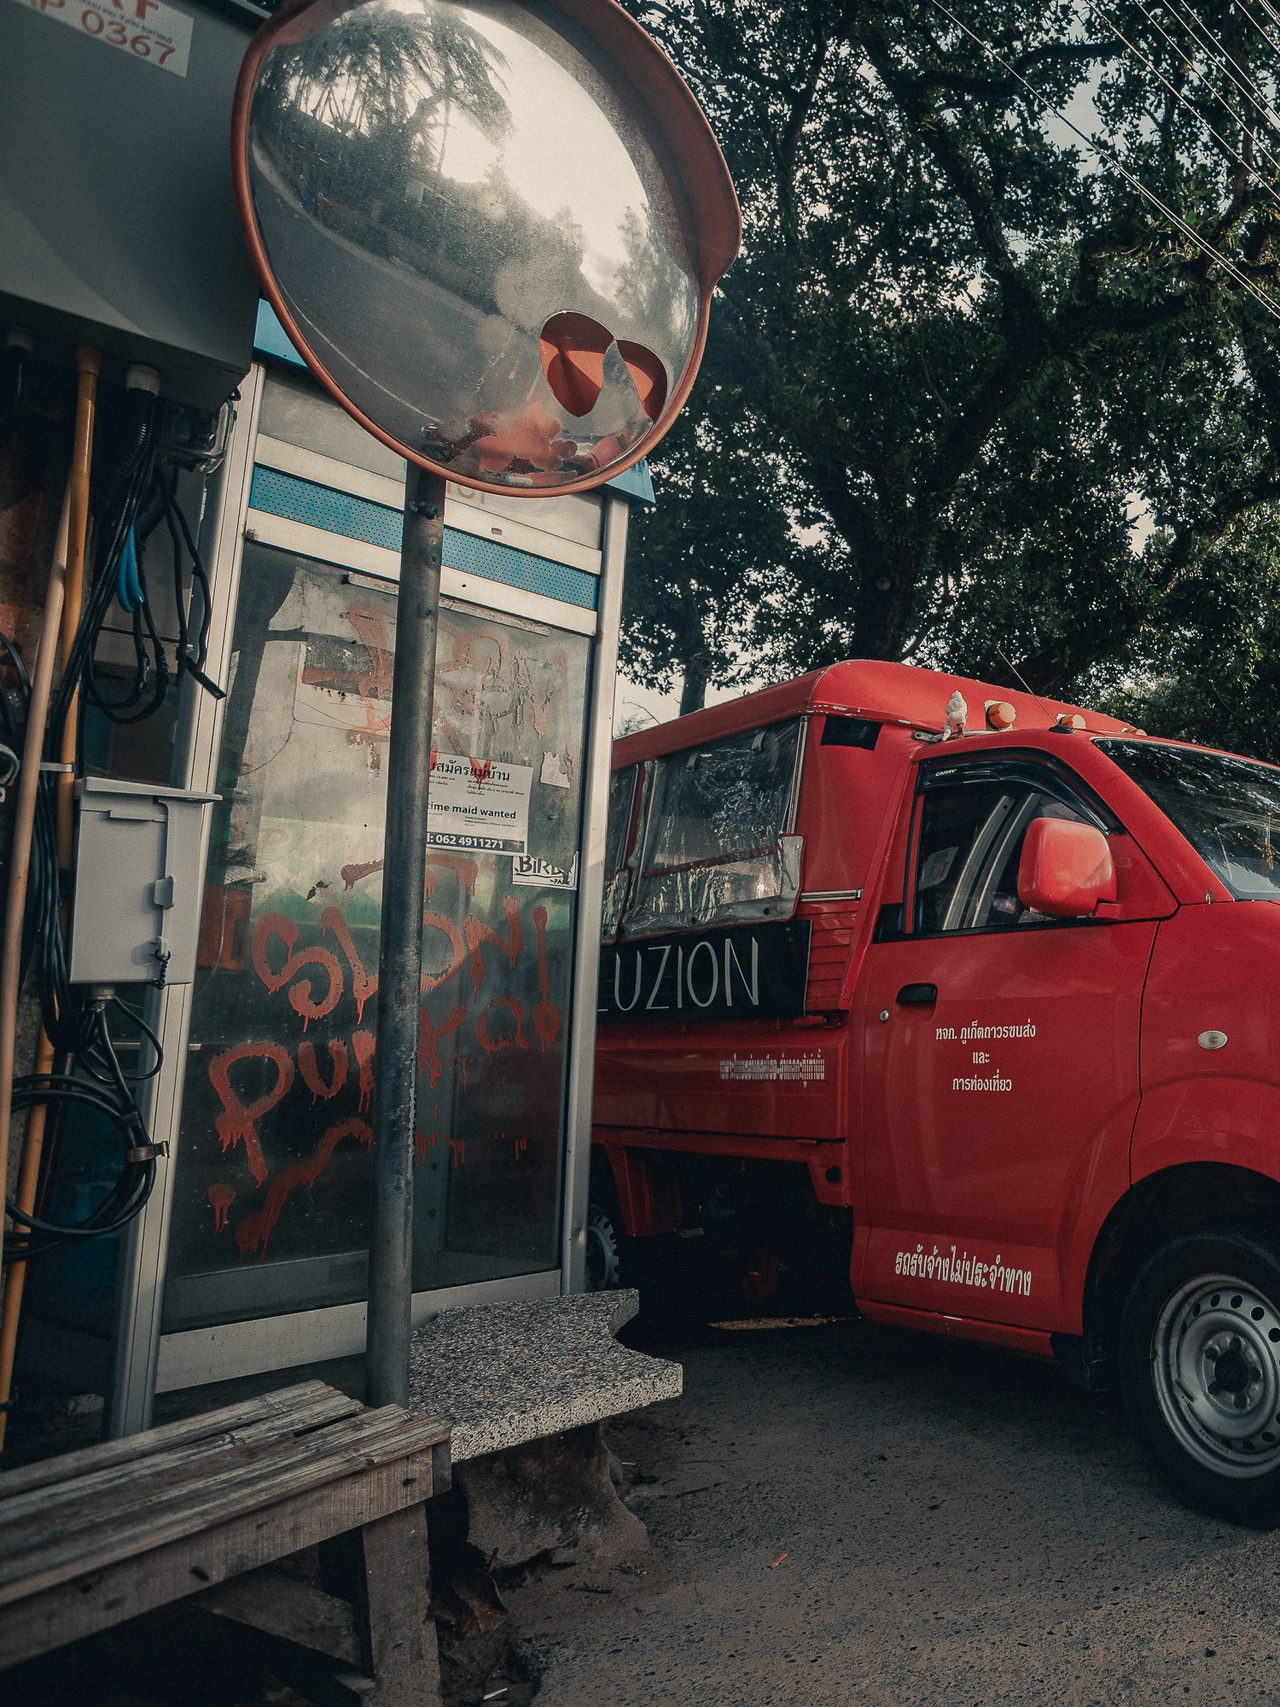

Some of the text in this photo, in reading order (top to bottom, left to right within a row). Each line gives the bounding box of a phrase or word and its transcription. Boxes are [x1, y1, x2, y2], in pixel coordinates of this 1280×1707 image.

[80, 8, 176, 66] 0367
[452, 806, 478, 815] maid
[480, 809, 516, 819] wanted
[436, 834, 457, 845] 062
[458, 835, 503, 849] 4911271
[554, 878, 571, 886] PAK
[935, 1018, 1036, 1045] หจก. ภูเก็ตถาวรขนส่ง
[972, 1051, 990, 1064] และ
[952, 1069, 1012, 1091] การท่องเที่ยว
[895, 1243, 1032, 1296] รถรับจ้างไม่ประจำทาง
